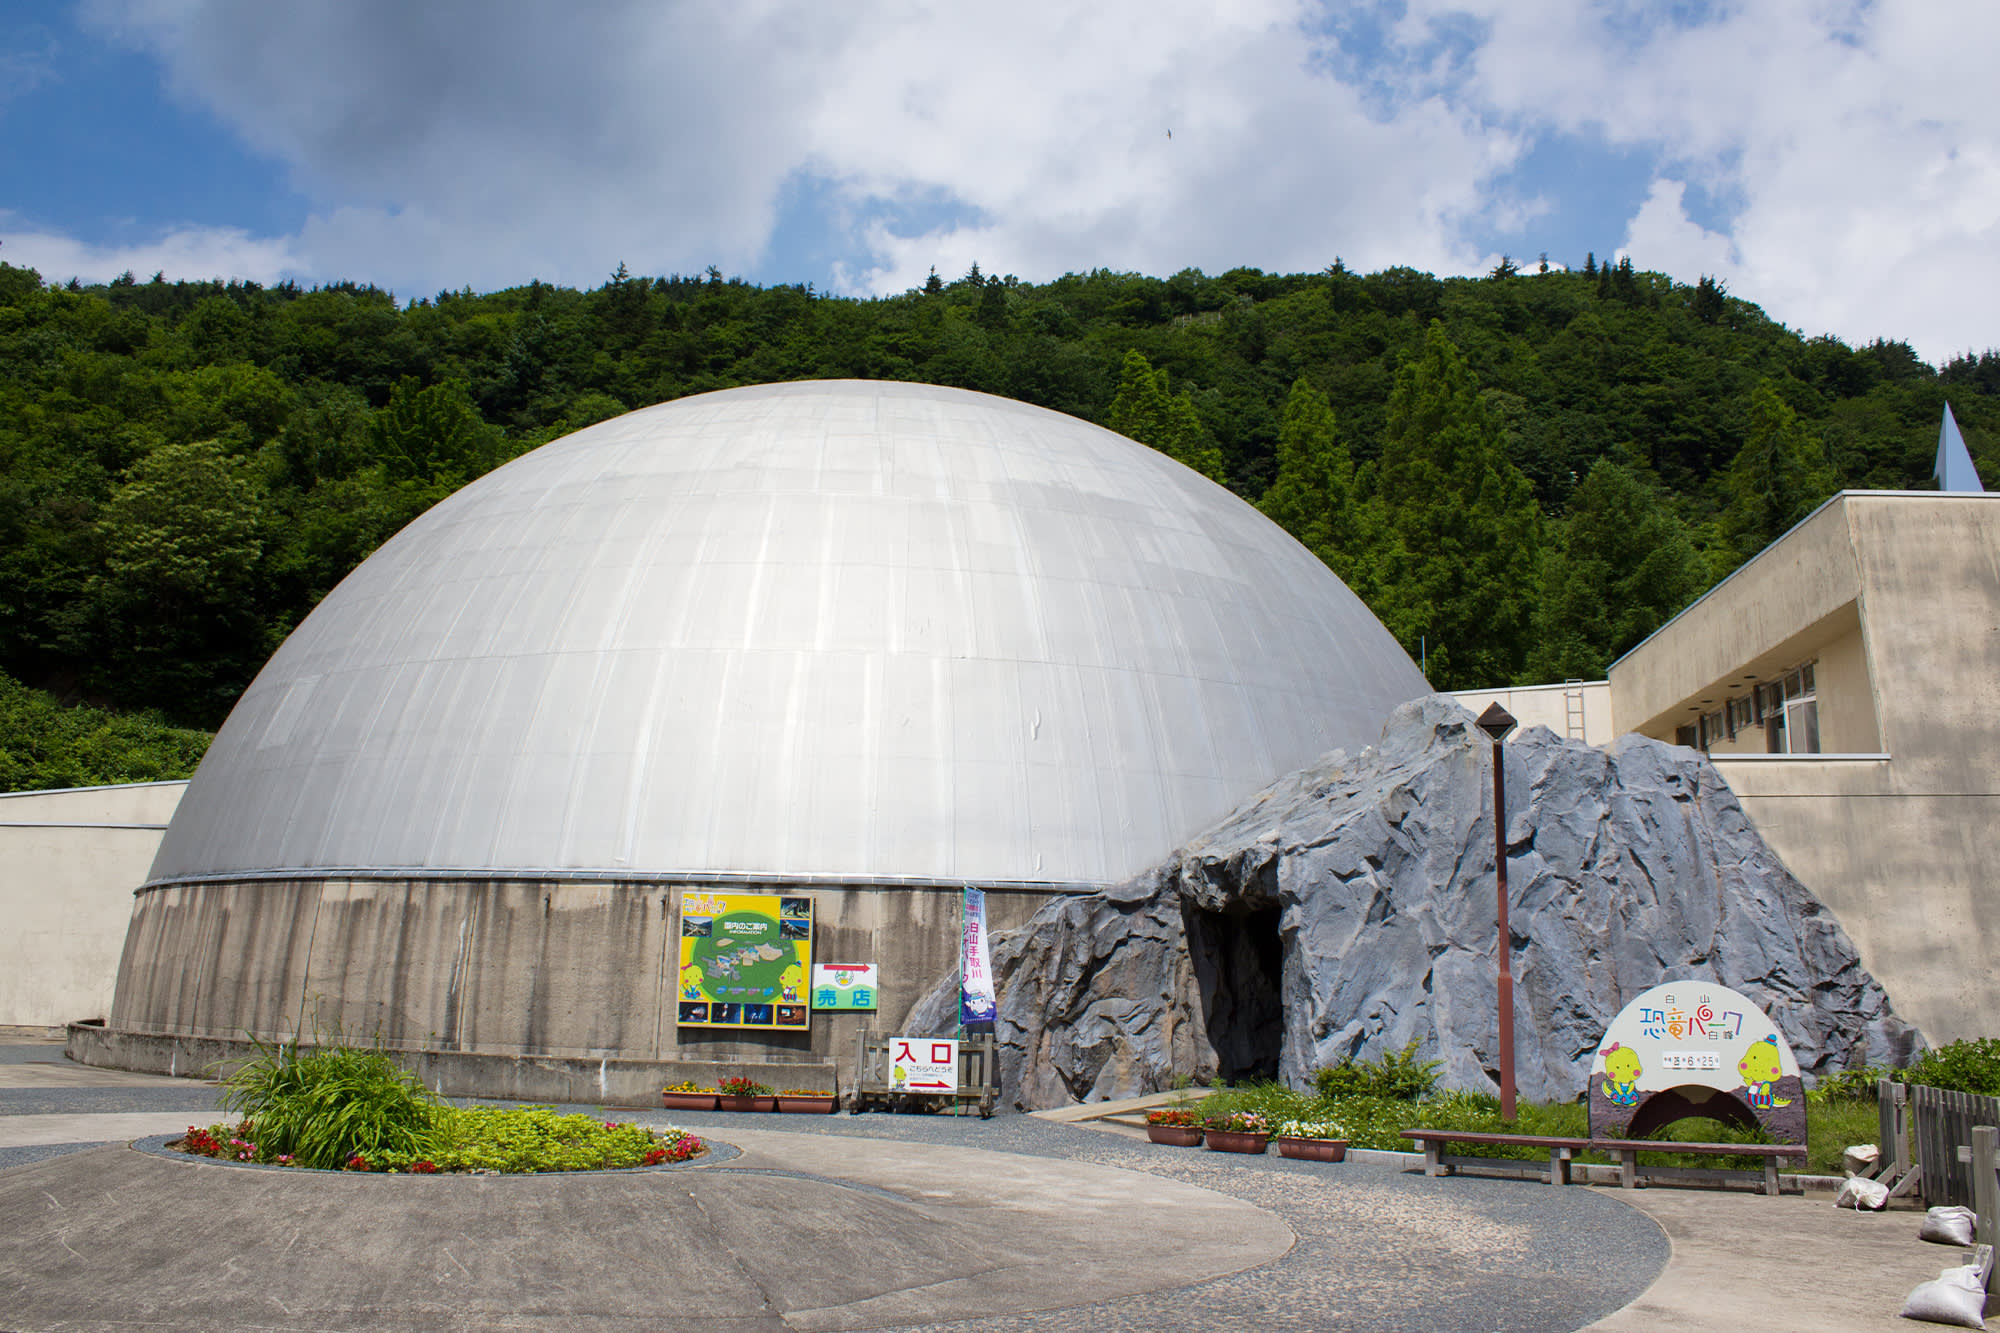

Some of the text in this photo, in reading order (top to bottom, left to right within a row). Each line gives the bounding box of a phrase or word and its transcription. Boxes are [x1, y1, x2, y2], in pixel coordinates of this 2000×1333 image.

[969, 922, 982, 979] 白山手取川
[817, 989, 871, 1007] 売店
[1665, 994, 1711, 1004] 白山
[895, 1042, 952, 1064] 入口
